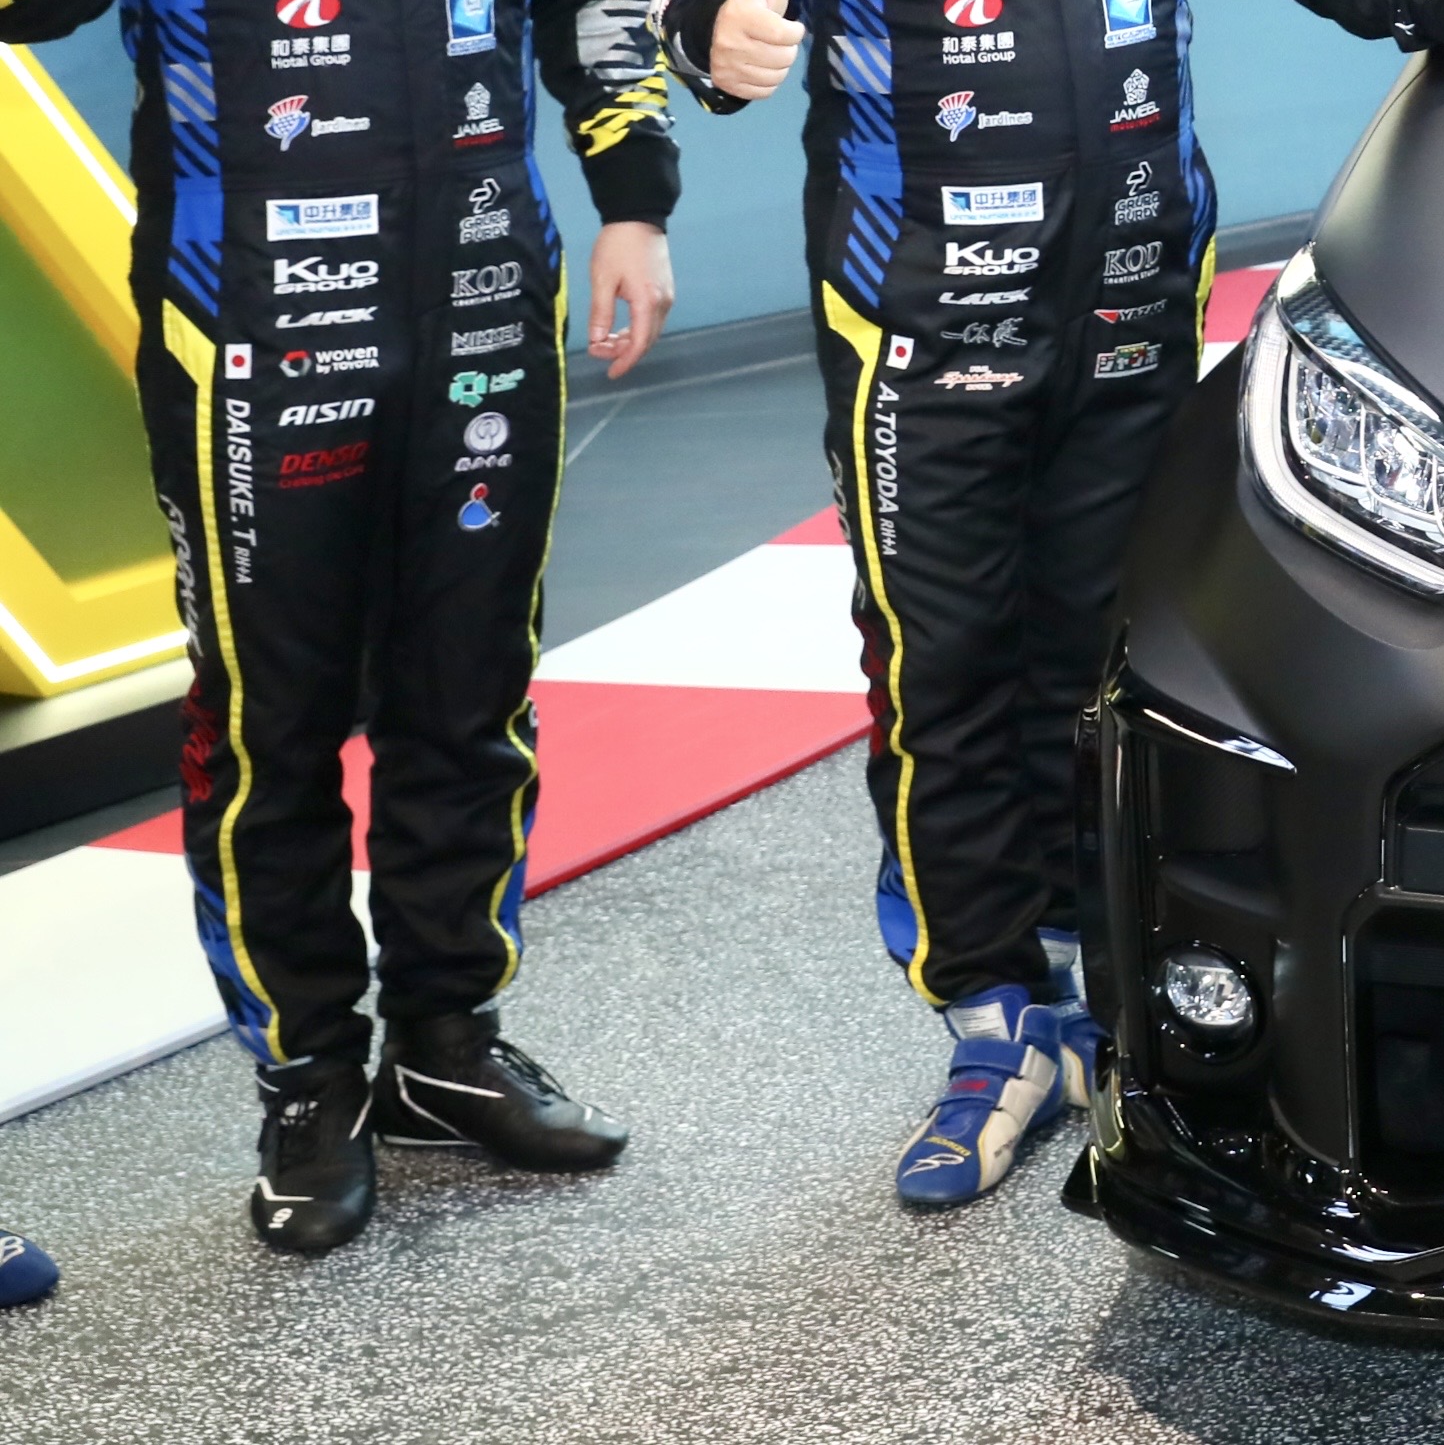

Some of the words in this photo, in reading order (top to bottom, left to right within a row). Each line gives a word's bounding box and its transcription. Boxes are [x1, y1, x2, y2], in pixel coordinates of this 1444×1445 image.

[271, 34, 350, 57] 和泰集團
[942, 31, 1014, 53] 和泰集團
[310, 53, 351, 67] Group
[977, 50, 1016, 64] Group
[1115, 191, 1160, 212] GRUPO
[1115, 203, 1160, 226] PURDY
[943, 262, 1039, 276] GROUP
[1103, 241, 1163, 276] KOD
[273, 277, 379, 295] GROUP
[450, 261, 523, 298] KOD
[451, 322, 525, 350] NIKKEN
[315, 363, 331, 375] by
[332, 358, 380, 372] TOYOTA
[278, 398, 376, 427] AISIN
[280, 441, 370, 475] DENSO
[880, 518, 897, 556] RH+A
